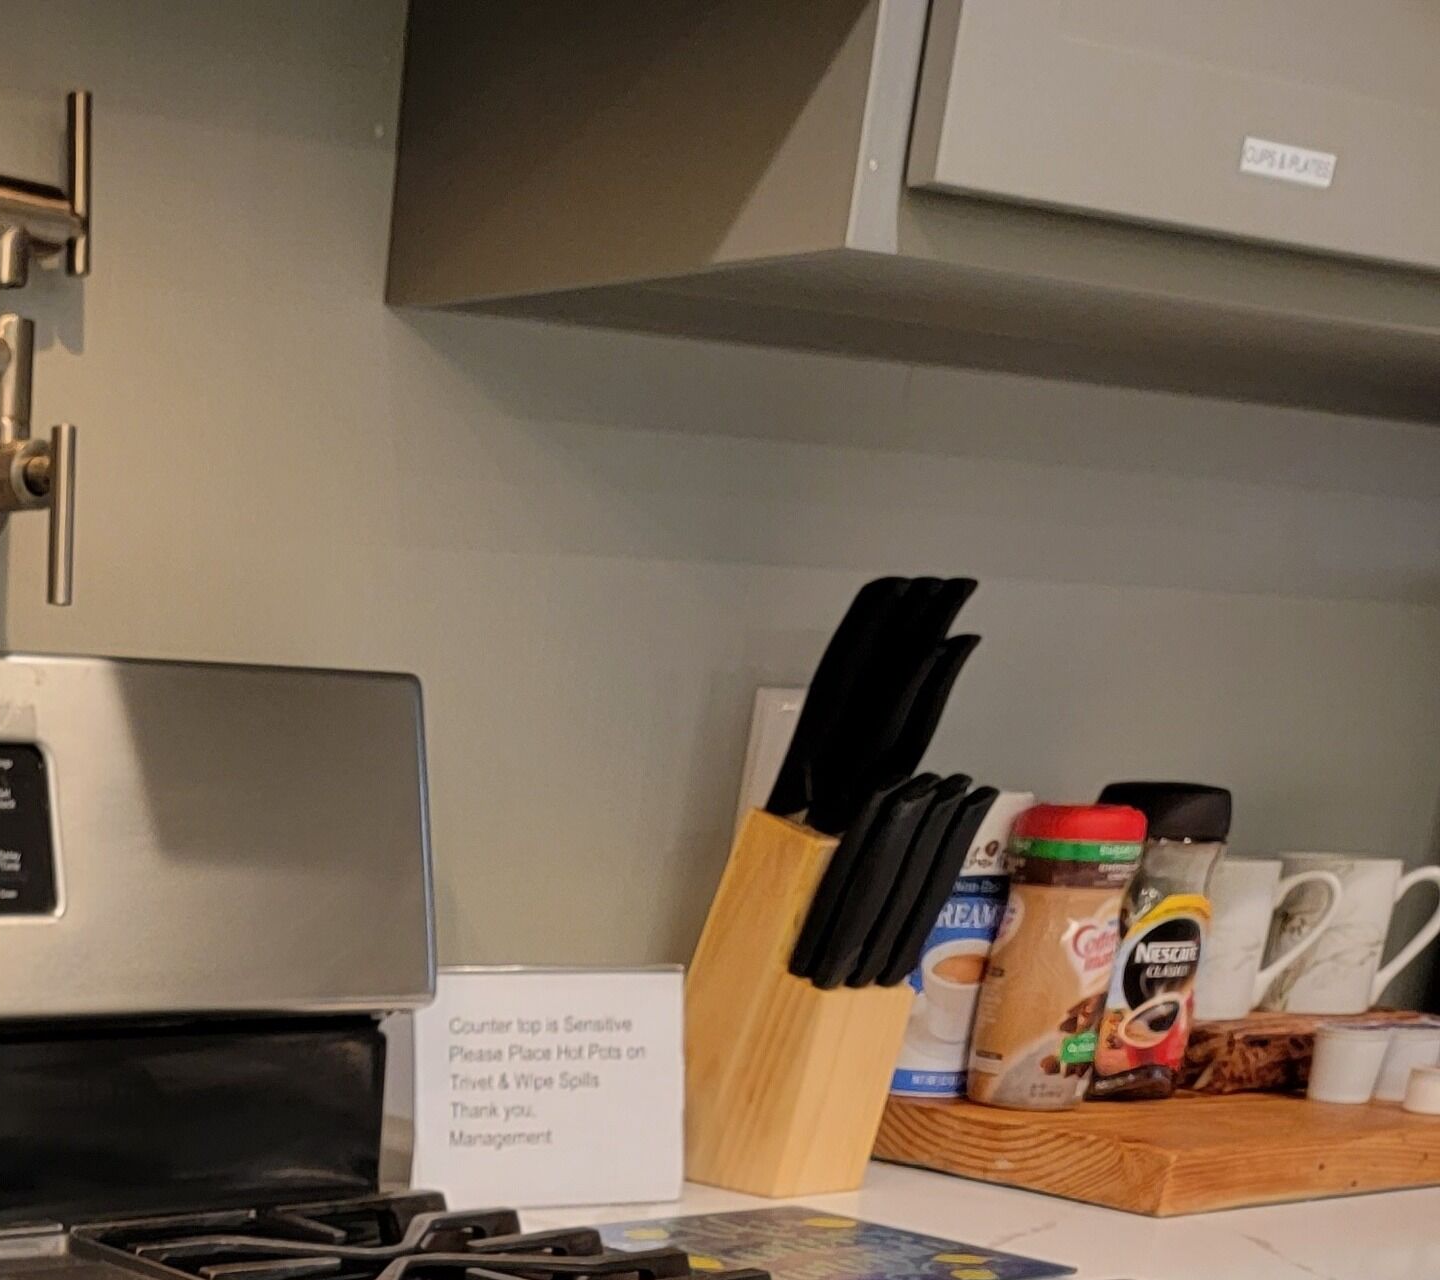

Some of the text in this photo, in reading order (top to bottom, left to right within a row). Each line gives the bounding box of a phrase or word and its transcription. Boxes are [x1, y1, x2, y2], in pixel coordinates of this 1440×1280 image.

[449, 1016, 632, 1036] Counter top is Sensitive
[449, 1043, 646, 1063] Please Place Hot Pots on
[451, 1072, 600, 1091] Trivet & Wipe Spills
[451, 1102, 498, 1119] Thank
[449, 1130, 553, 1149] Management
